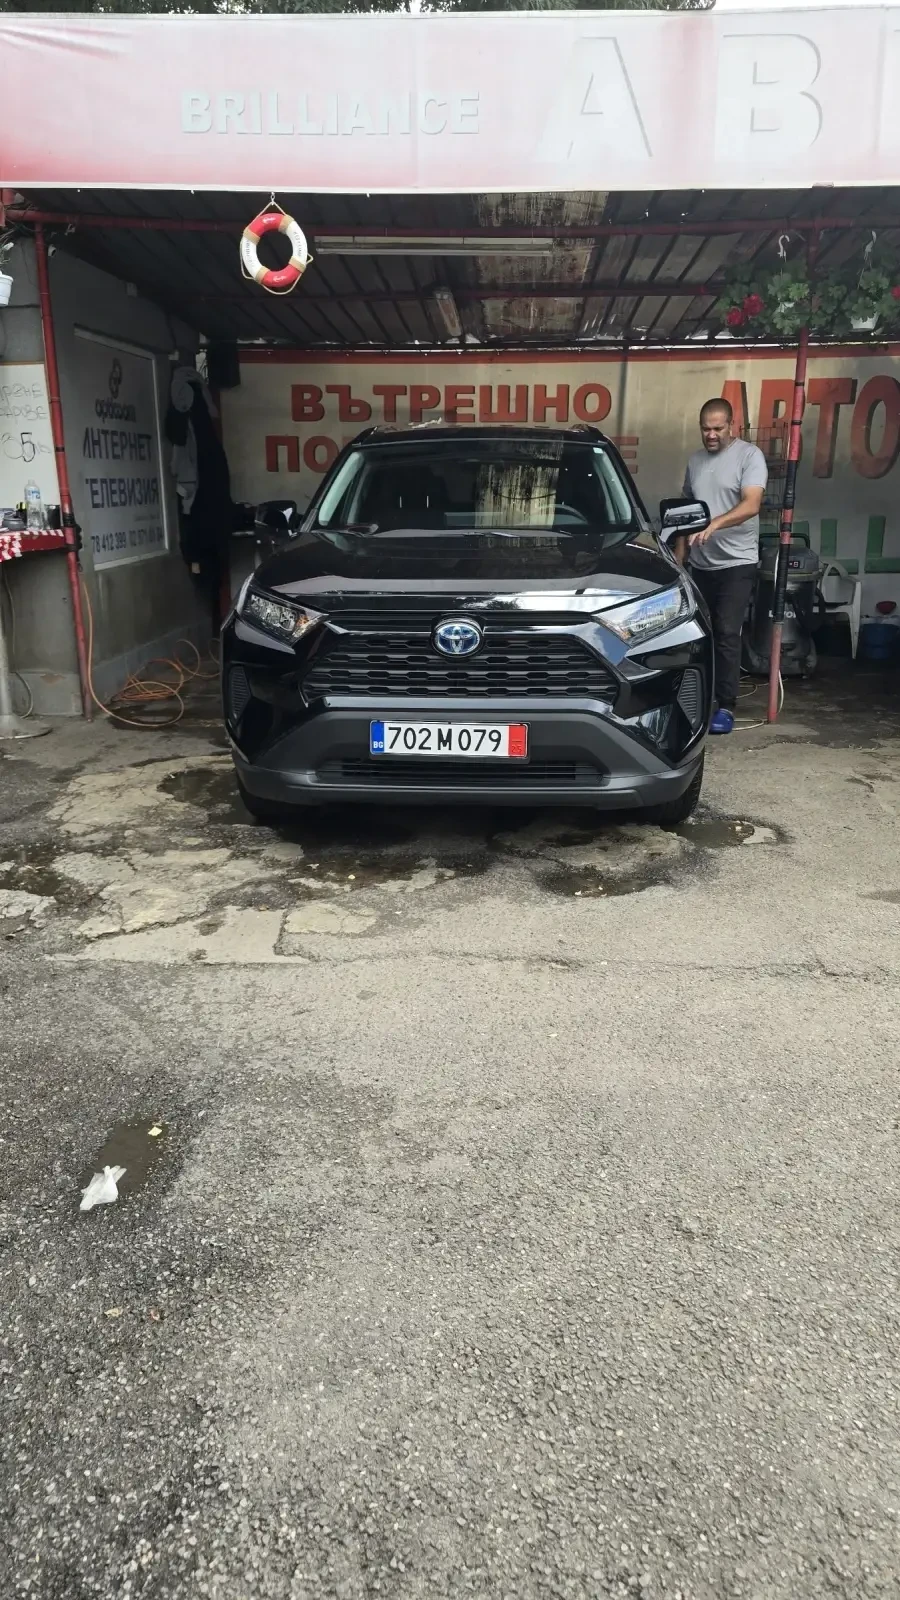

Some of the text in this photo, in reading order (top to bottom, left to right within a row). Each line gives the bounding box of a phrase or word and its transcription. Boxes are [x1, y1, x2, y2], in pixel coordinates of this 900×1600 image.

[180, 91, 480, 135] BRILLIANCE
[291, 383, 612, 423] ВЪТРЕШНО
[373, 741, 383, 749] BG
